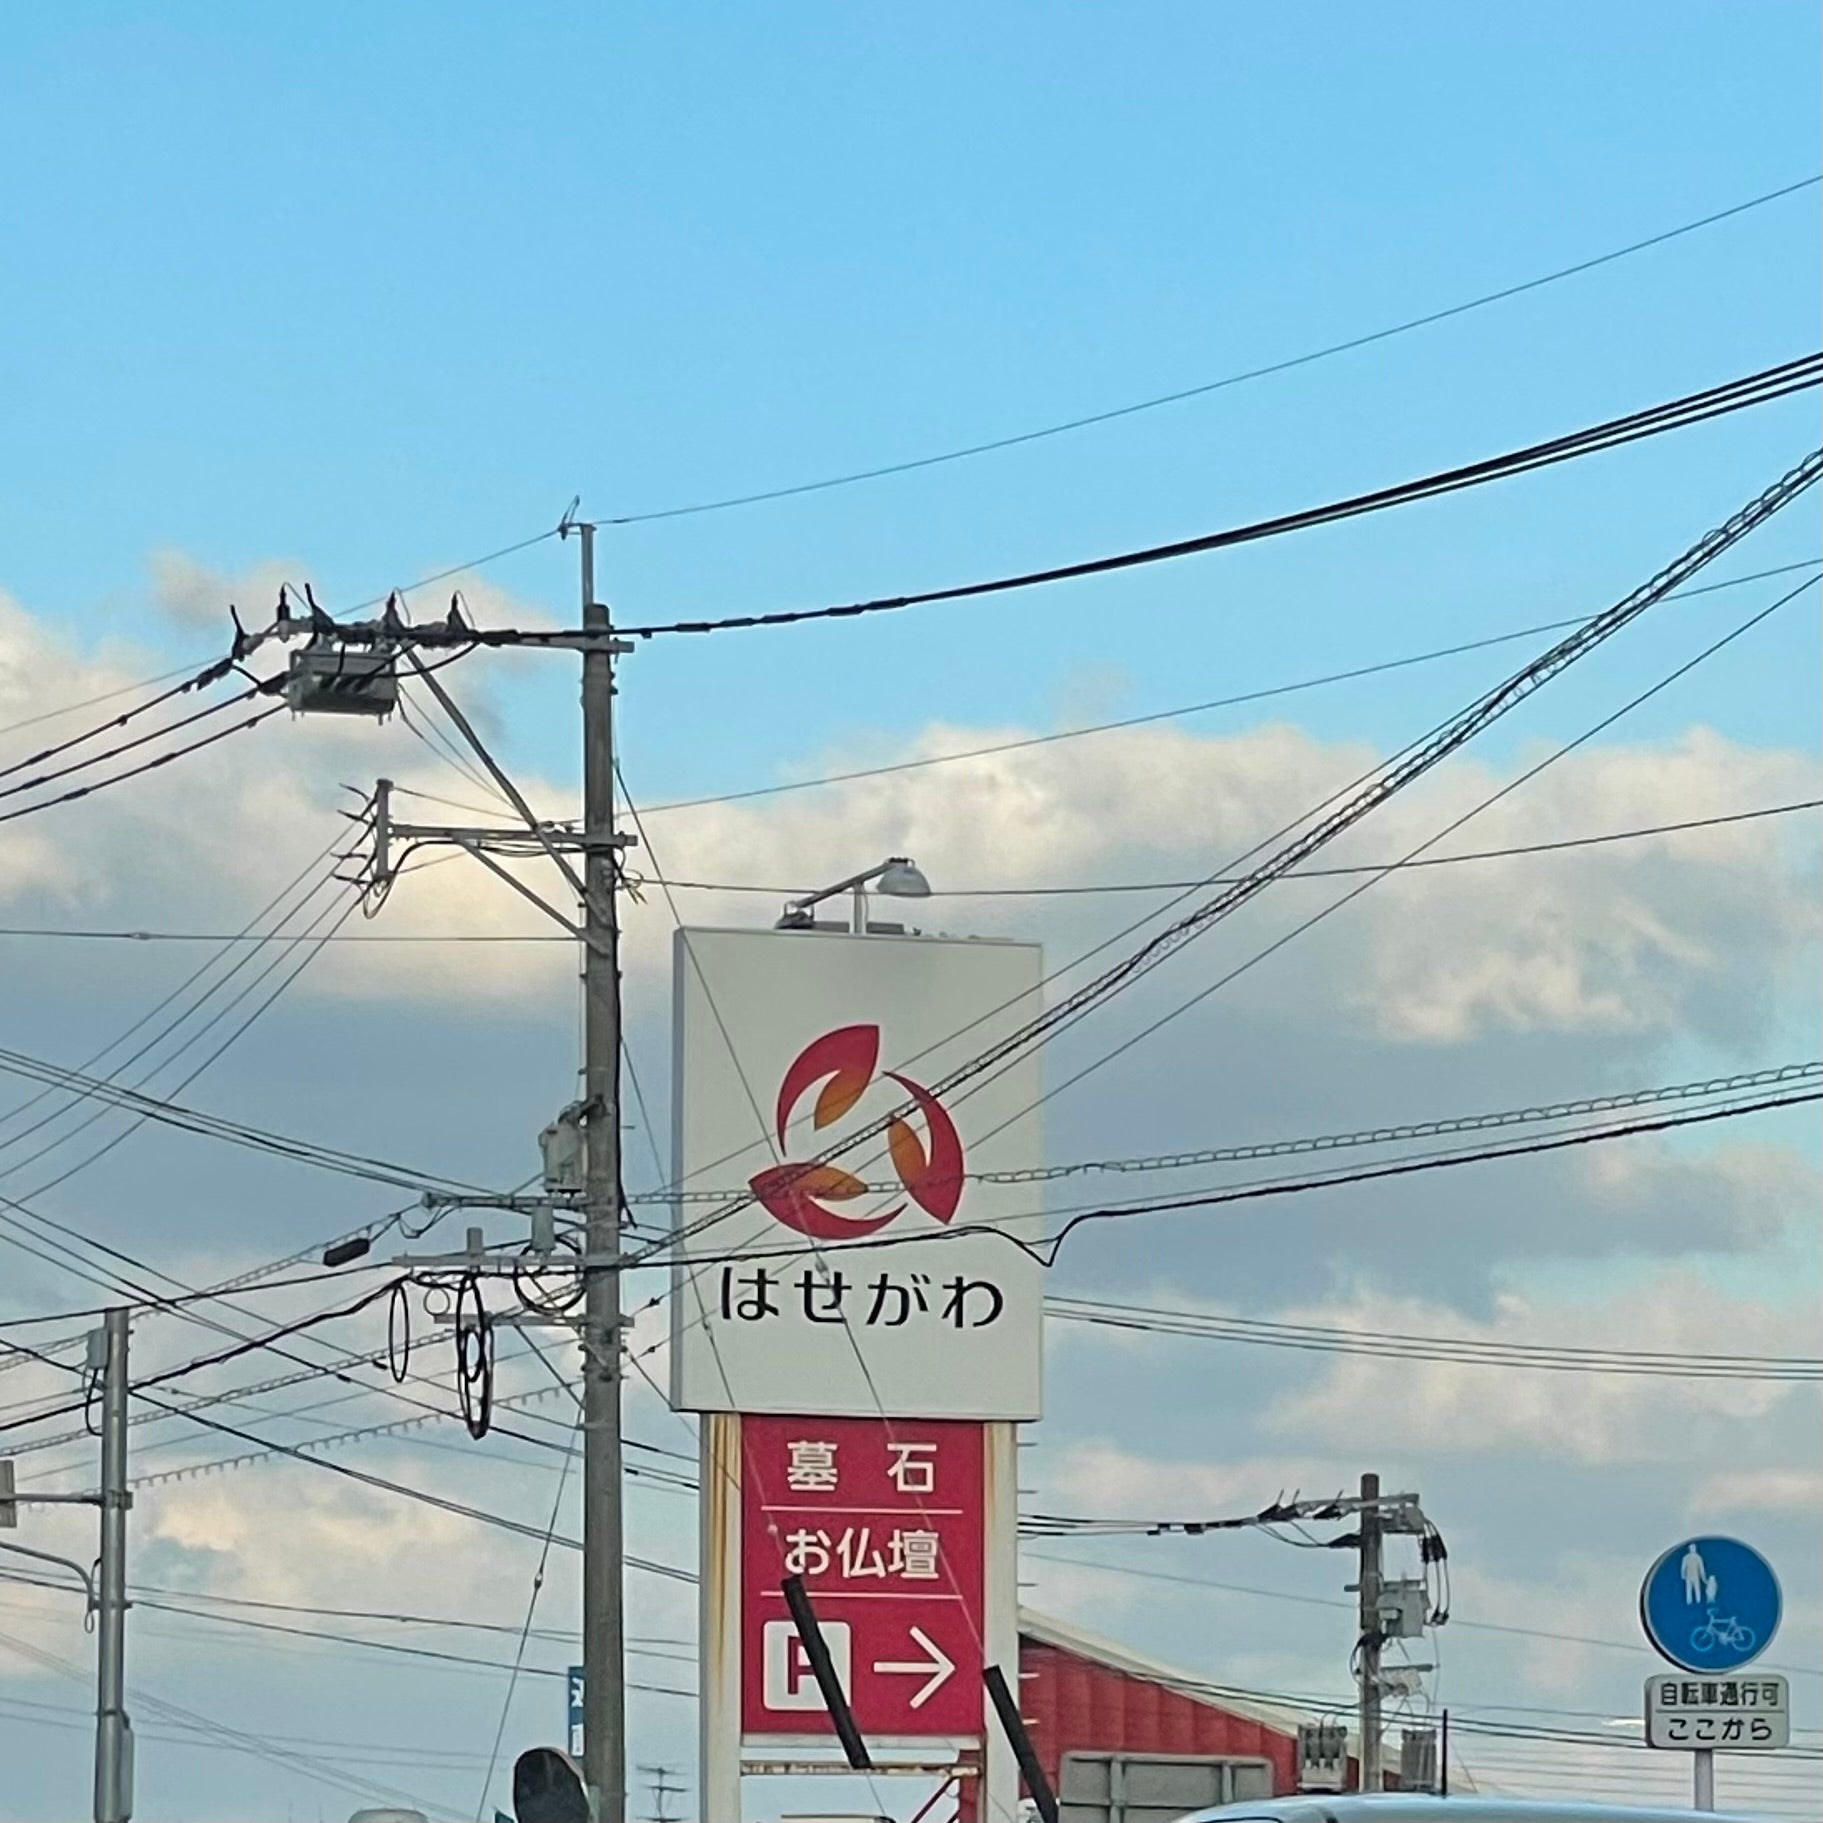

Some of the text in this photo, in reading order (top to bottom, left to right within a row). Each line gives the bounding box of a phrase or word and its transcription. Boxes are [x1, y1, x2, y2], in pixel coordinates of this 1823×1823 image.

[720, 1266, 1004, 1328] はせがわ
[787, 1441, 937, 1492] 墓石
[785, 1527, 939, 1578] お仏壇
[1661, 1682, 1779, 1706] 自転車通行可
[1668, 1718, 1772, 1741] ここから
